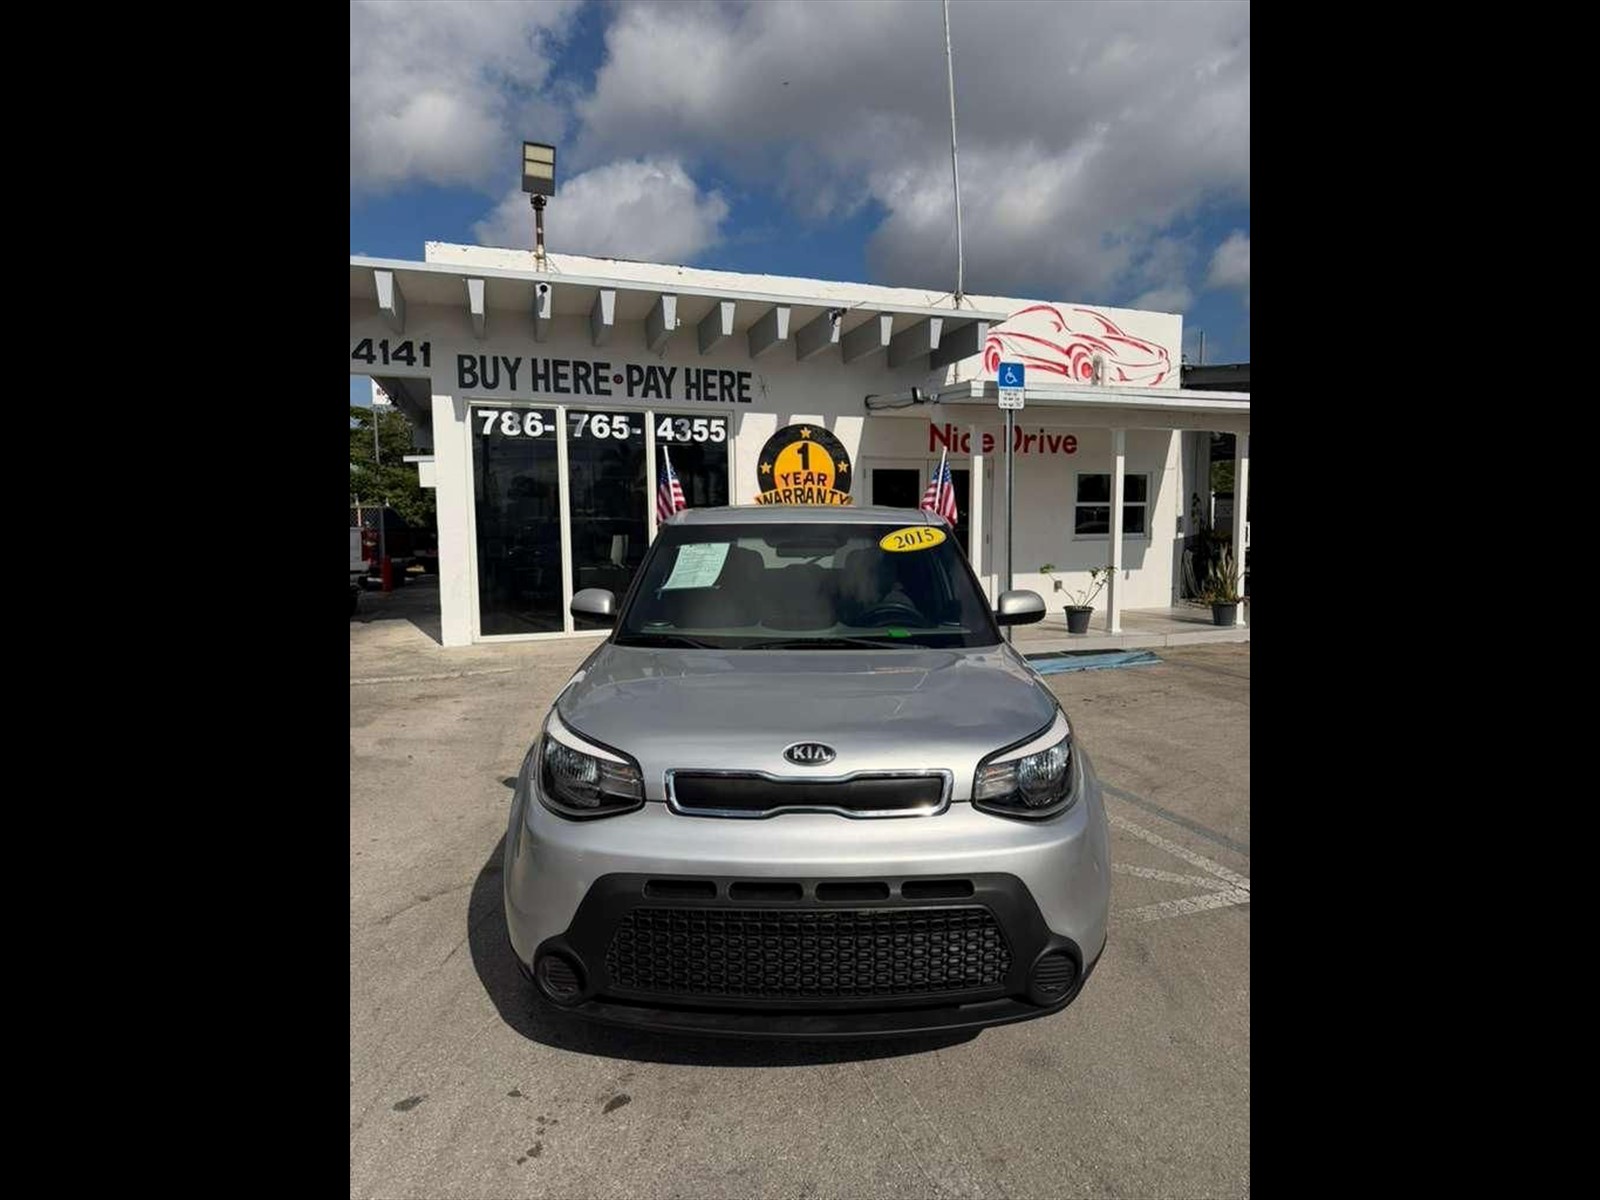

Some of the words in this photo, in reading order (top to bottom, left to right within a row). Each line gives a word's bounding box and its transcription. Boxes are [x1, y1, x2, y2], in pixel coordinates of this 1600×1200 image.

[351, 338, 431, 367] 4141
[457, 353, 522, 390] BUY
[531, 358, 613, 396] HERE
[626, 364, 678, 399] PAY
[685, 367, 753, 403] HERE
[477, 409, 556, 437] 786-
[569, 413, 642, 440] 765-
[656, 416, 726, 442] 4355
[797, 442, 810, 470] 1
[780, 471, 828, 487] YEAR
[755, 487, 850, 505] WARRANTY
[893, 528, 935, 550] 2015
[793, 745, 827, 760] KIA
